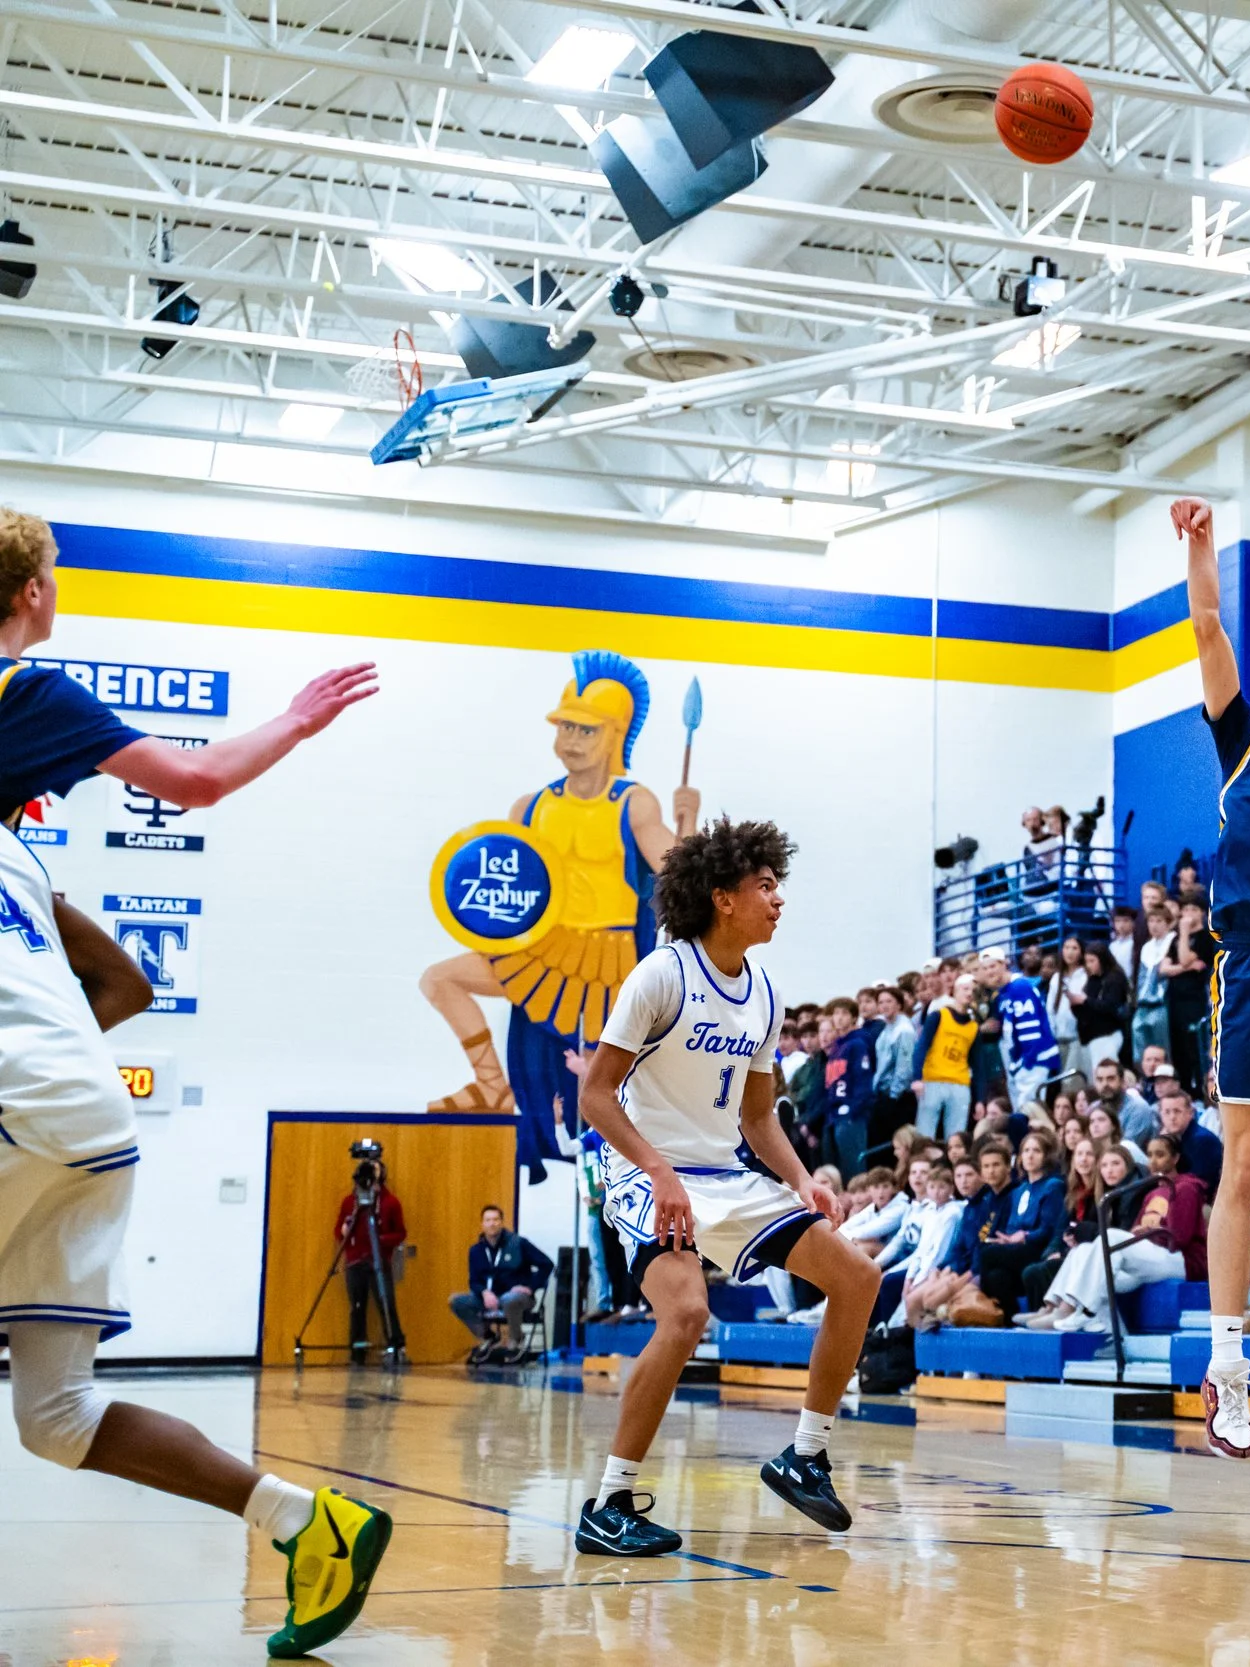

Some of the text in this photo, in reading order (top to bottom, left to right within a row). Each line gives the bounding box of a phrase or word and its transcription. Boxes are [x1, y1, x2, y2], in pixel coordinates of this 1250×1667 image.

[18, 659, 216, 711] RENCE
[124, 832, 186, 849] CADETS
[479, 846, 520, 883] Led
[117, 896, 188, 913] TARTAN
[458, 878, 541, 923] Zephyr
[713, 1064, 736, 1110] 1
